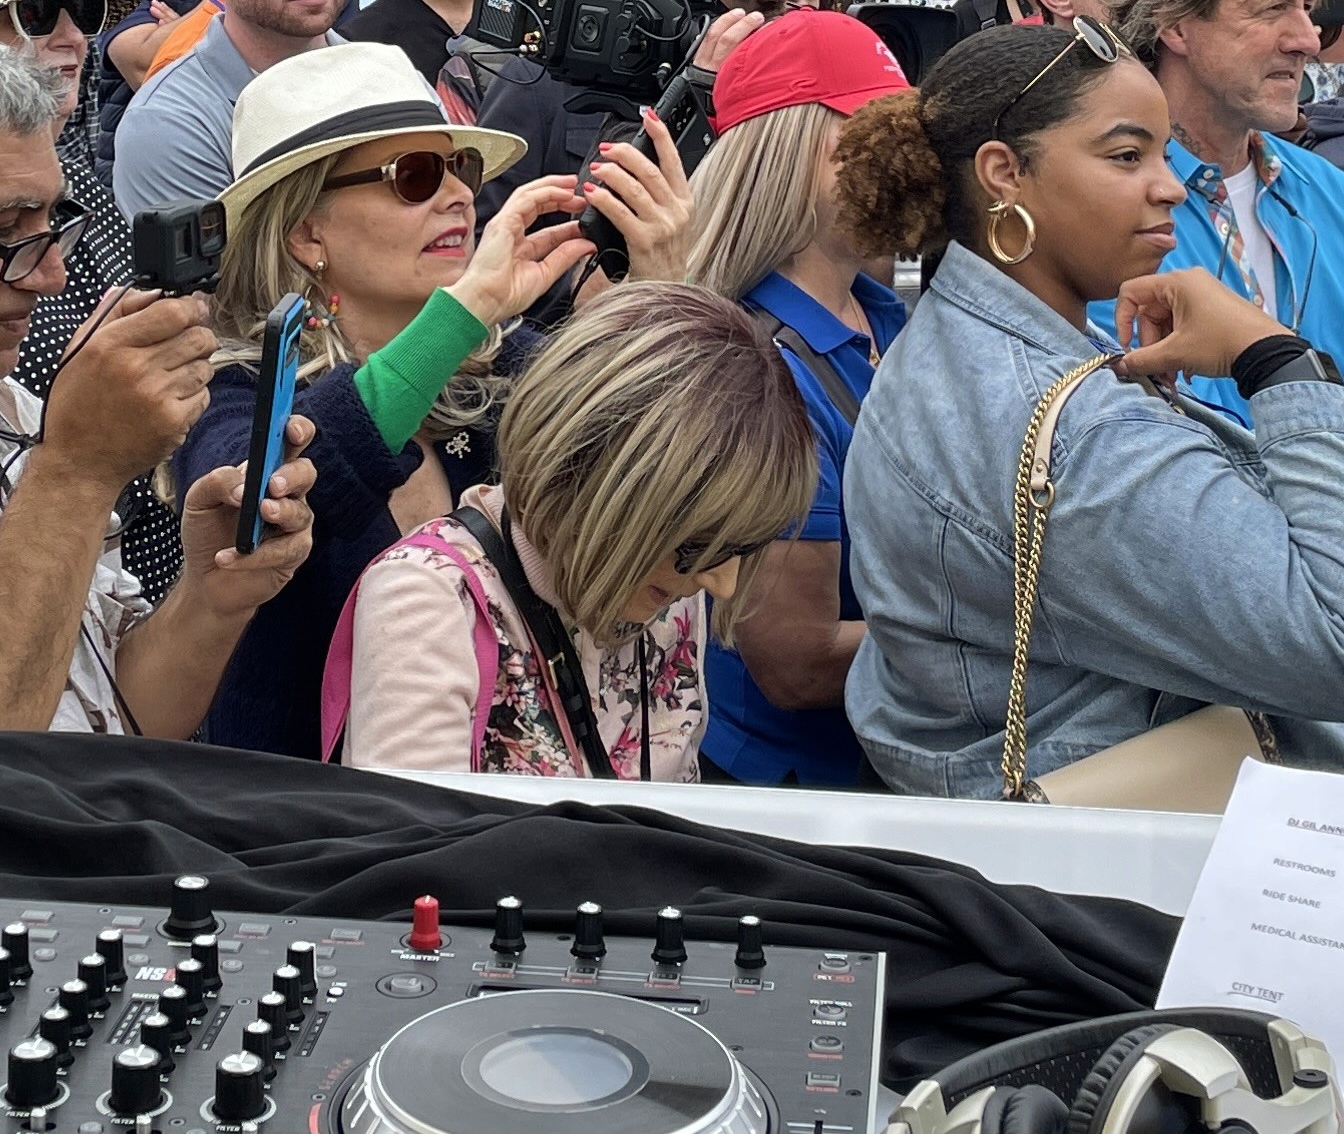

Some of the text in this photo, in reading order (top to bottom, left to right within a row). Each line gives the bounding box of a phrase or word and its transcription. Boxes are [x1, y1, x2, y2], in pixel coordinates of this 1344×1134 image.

[1287, 817, 1300, 827] DJ
[1272, 858, 1336, 878] RESTROOMS
[1262, 889, 1321, 909] RIDE SHARE
[1250, 922, 1298, 941] MEDICAL
[399, 953, 440, 962] MASTER
[1231, 981, 1285, 1002] CITY TENT
